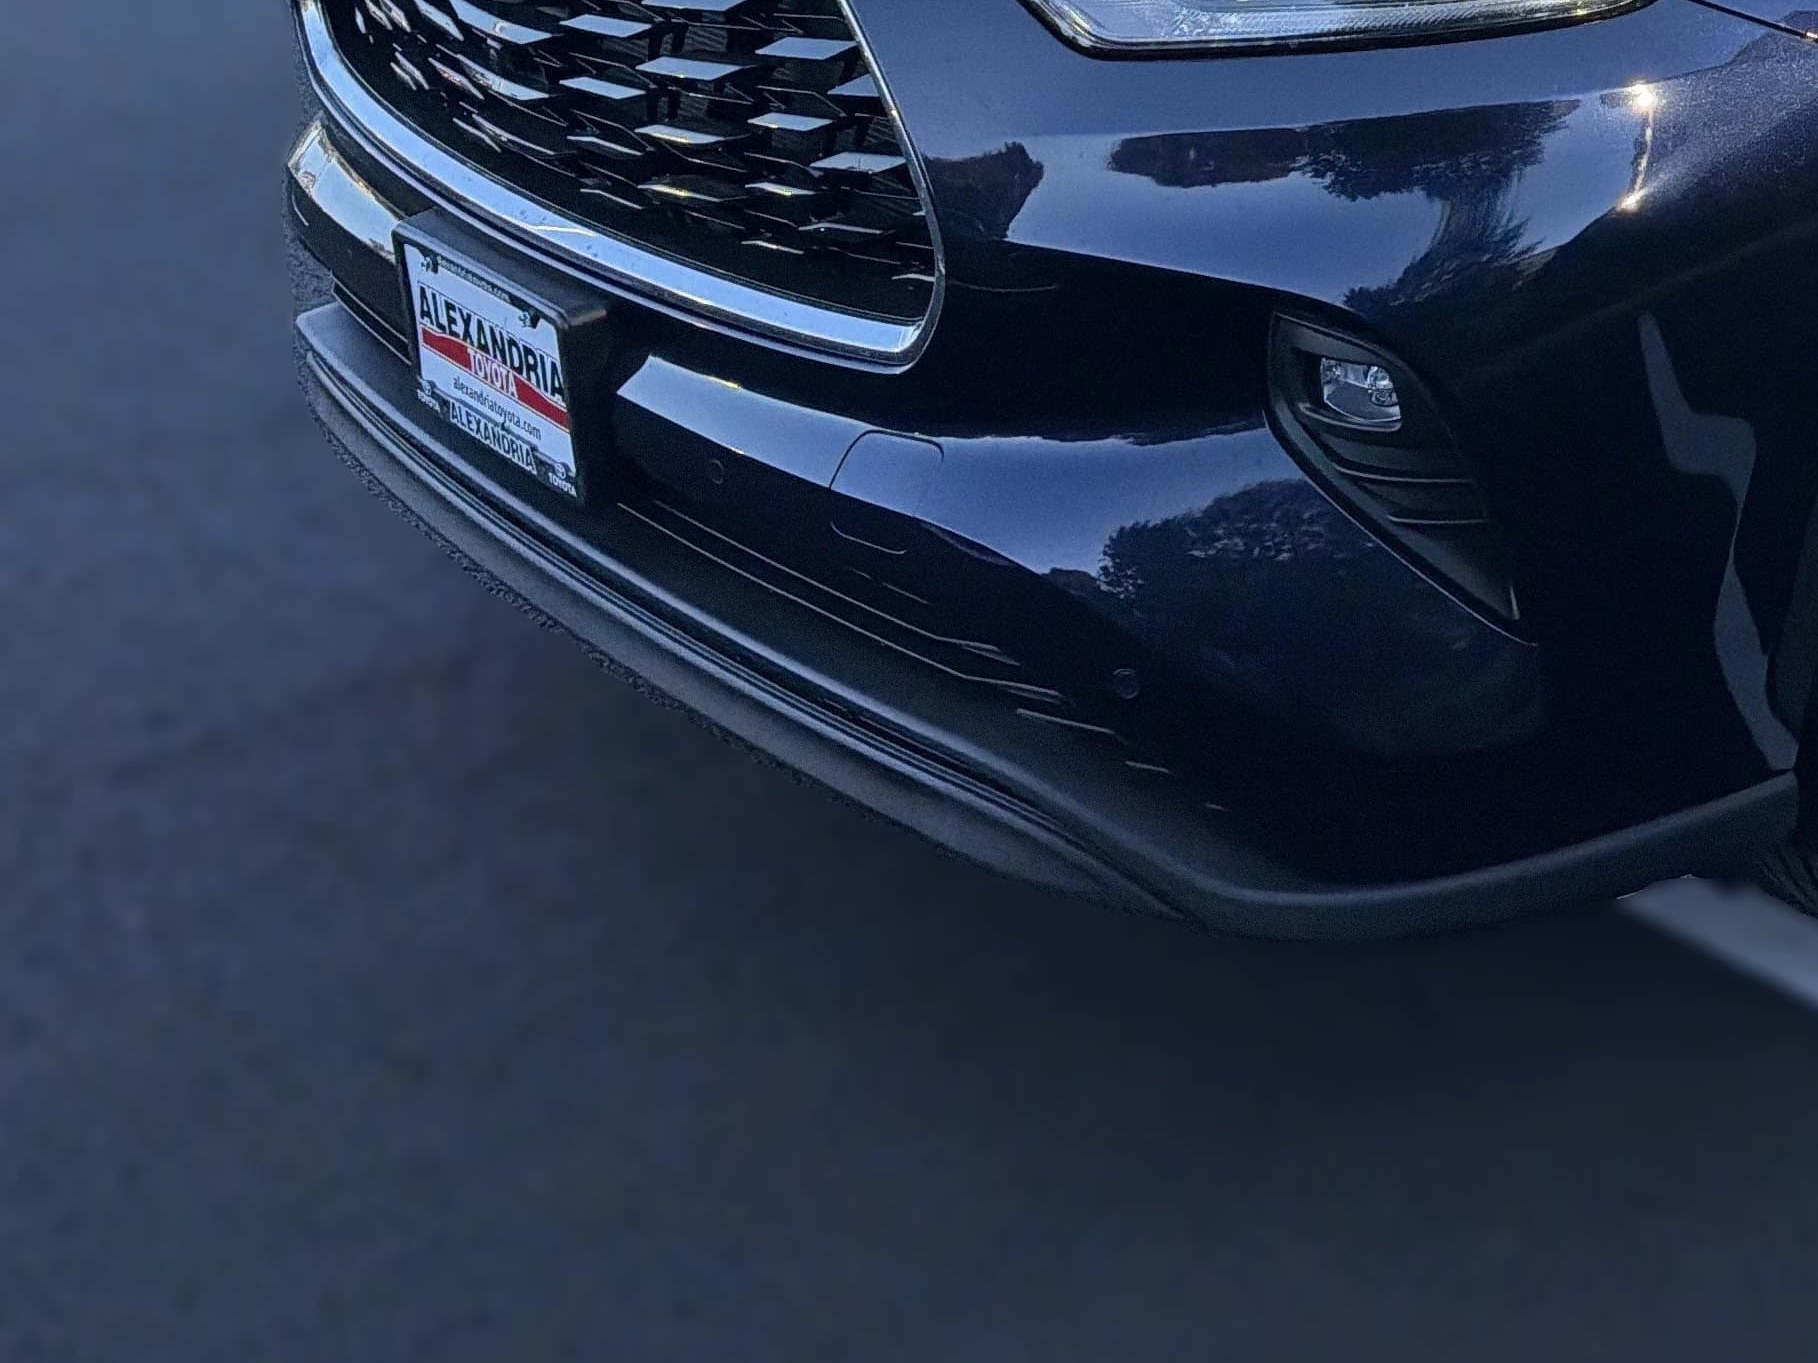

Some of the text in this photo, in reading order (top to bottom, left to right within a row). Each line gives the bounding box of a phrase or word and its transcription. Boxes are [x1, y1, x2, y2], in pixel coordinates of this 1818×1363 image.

[419, 285, 564, 404] ALEXANDRIA
[467, 347, 518, 398] TOYOTA
[450, 401, 537, 475] ALEXANDRIA
[453, 374, 542, 441] alexandriatoyota.com
[548, 471, 577, 497] TOYOTA
